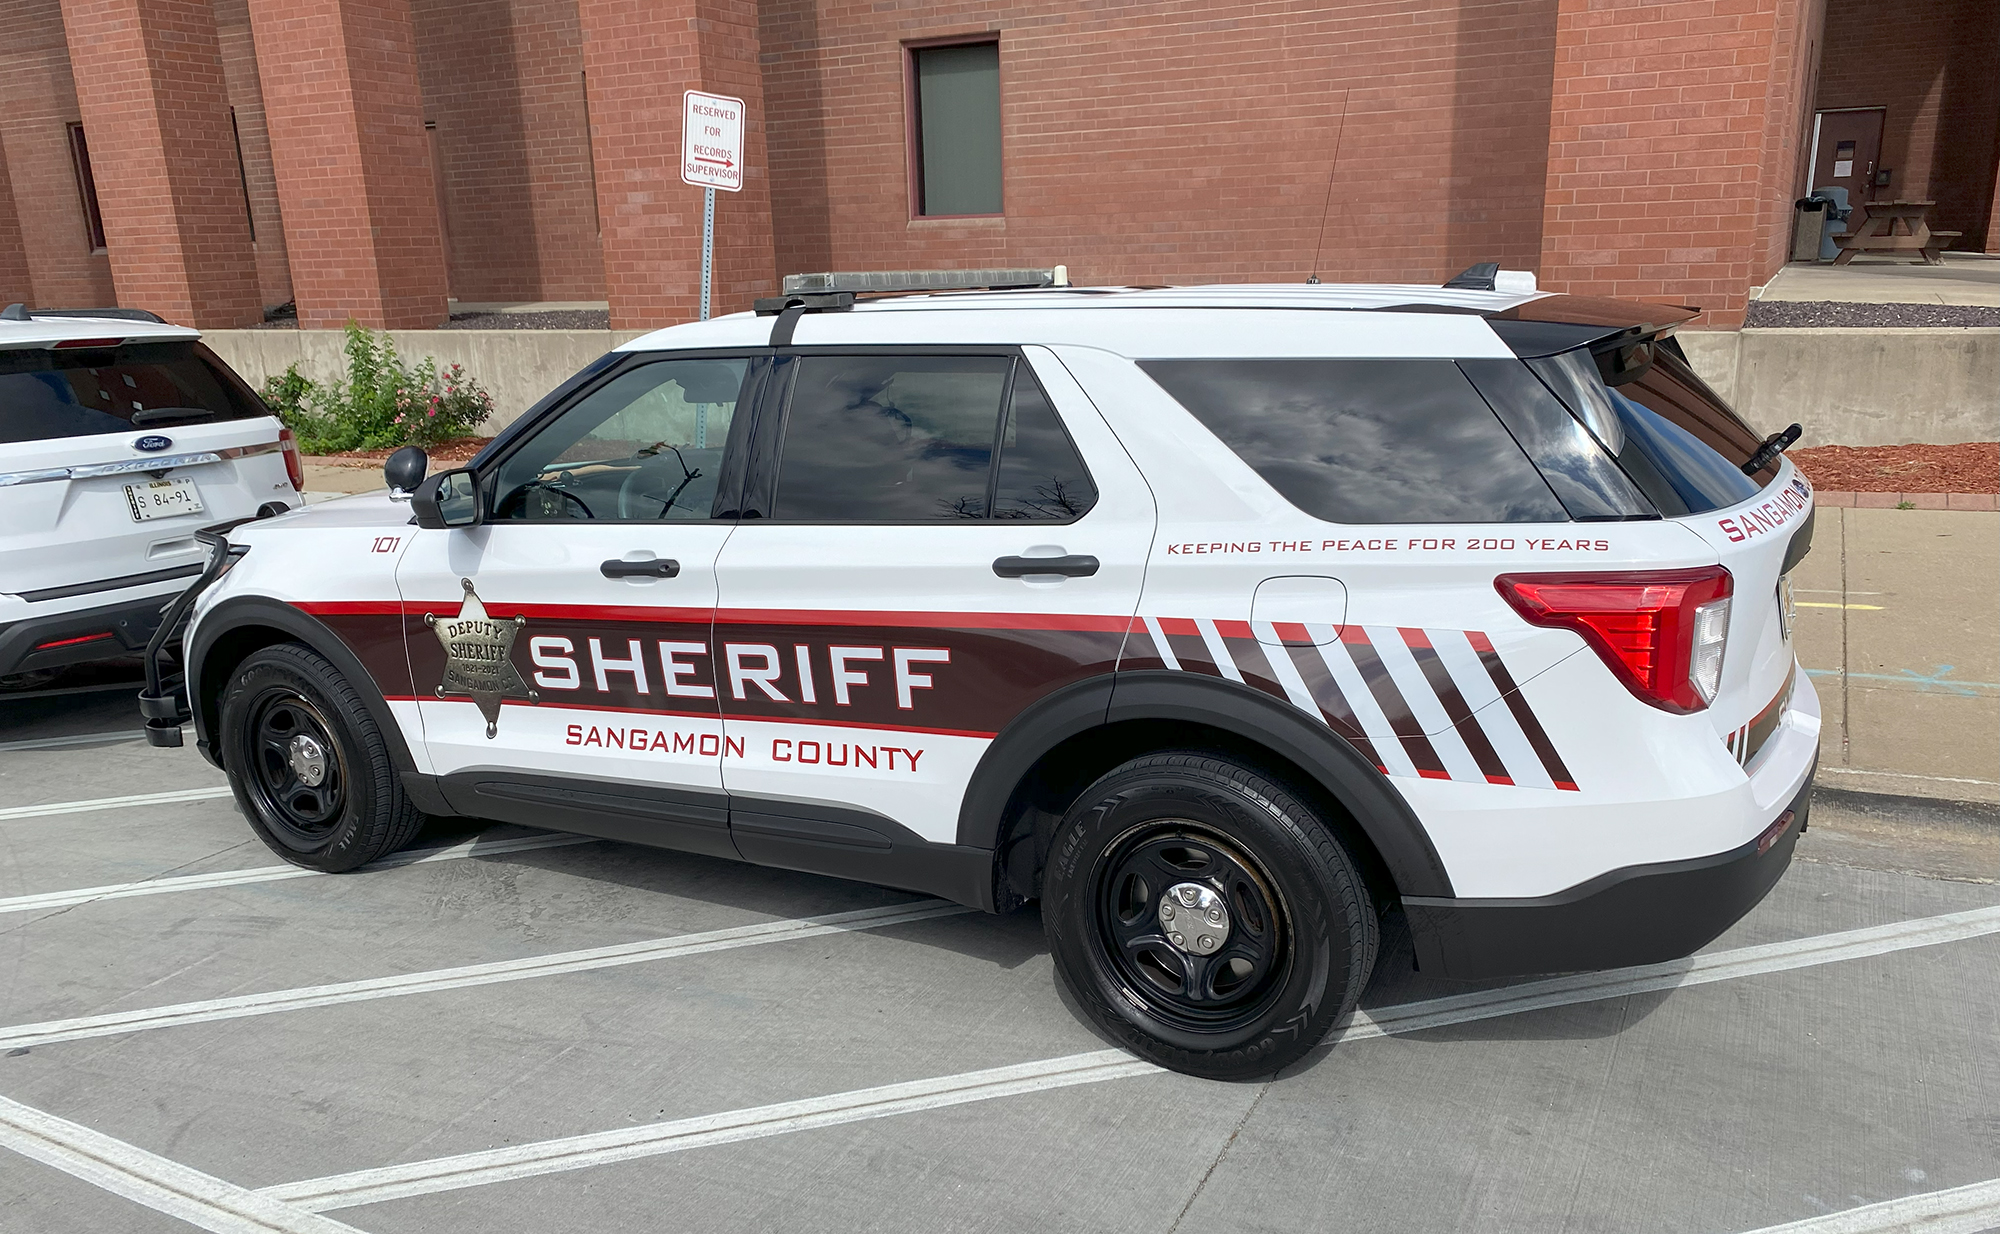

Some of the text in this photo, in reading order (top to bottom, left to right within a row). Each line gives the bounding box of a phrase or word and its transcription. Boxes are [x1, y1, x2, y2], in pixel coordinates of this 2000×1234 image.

[692, 104, 736, 121] RESERVED
[704, 125, 721, 137] FOR
[693, 144, 732, 160] RECORDS
[686, 163, 739, 180] SUPERVISOR
[142, 437, 166, 449] Ford
[148, 480, 172, 489] ILLINOIS
[137, 495, 147, 509] S
[153, 489, 192, 506] 84-91
[1717, 484, 1807, 543] SANGAMON
[371, 536, 401, 553] 101
[1167, 538, 1610, 555] KEEPING THE PEACE FOR 200 YEARS
[447, 620, 503, 640] DEPUTY
[450, 642, 507, 661] SHERIFF
[461, 662, 501, 675] 1821-2021
[529, 635, 952, 711] SHERIFF
[448, 669, 500, 692] SANGAMON
[565, 723, 925, 773] SANGAMON COUNTY
[1054, 820, 1087, 882] EAGLE
